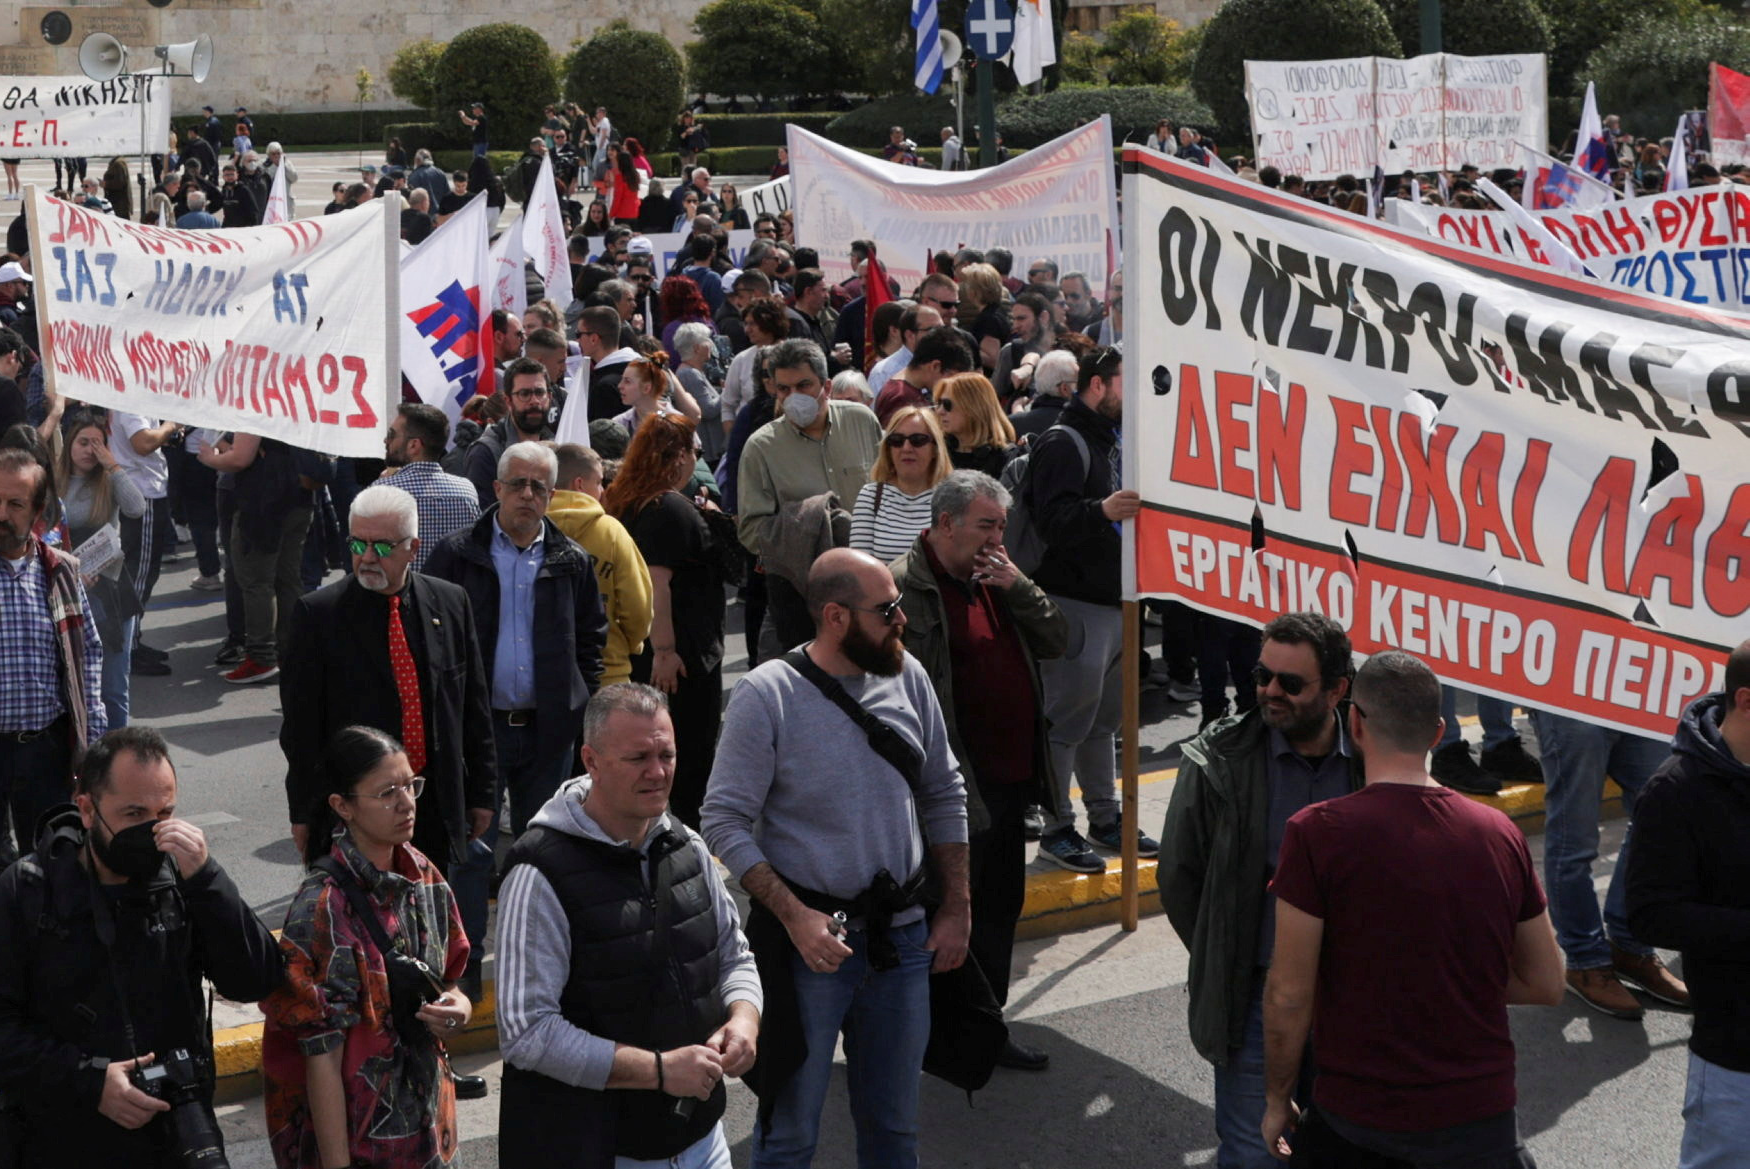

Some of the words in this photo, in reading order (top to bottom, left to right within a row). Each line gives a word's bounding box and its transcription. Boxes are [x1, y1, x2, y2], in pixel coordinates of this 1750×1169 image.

[2, 86, 39, 110] ΘΑ
[1159, 206, 1222, 331] ΟΙ
[1233, 230, 1512, 395] ΝΕΚΡΟΙ
[1504, 309, 1711, 439] ΜΑΣ
[1170, 363, 1307, 511] ΔΕΝ
[1328, 395, 1552, 567] ΕΙΝΑΙ
[1167, 528, 1354, 633] ΕΡΓΑΤΙΚΟ
[1370, 580, 1557, 686] ΚΕΝΤΡΟ
